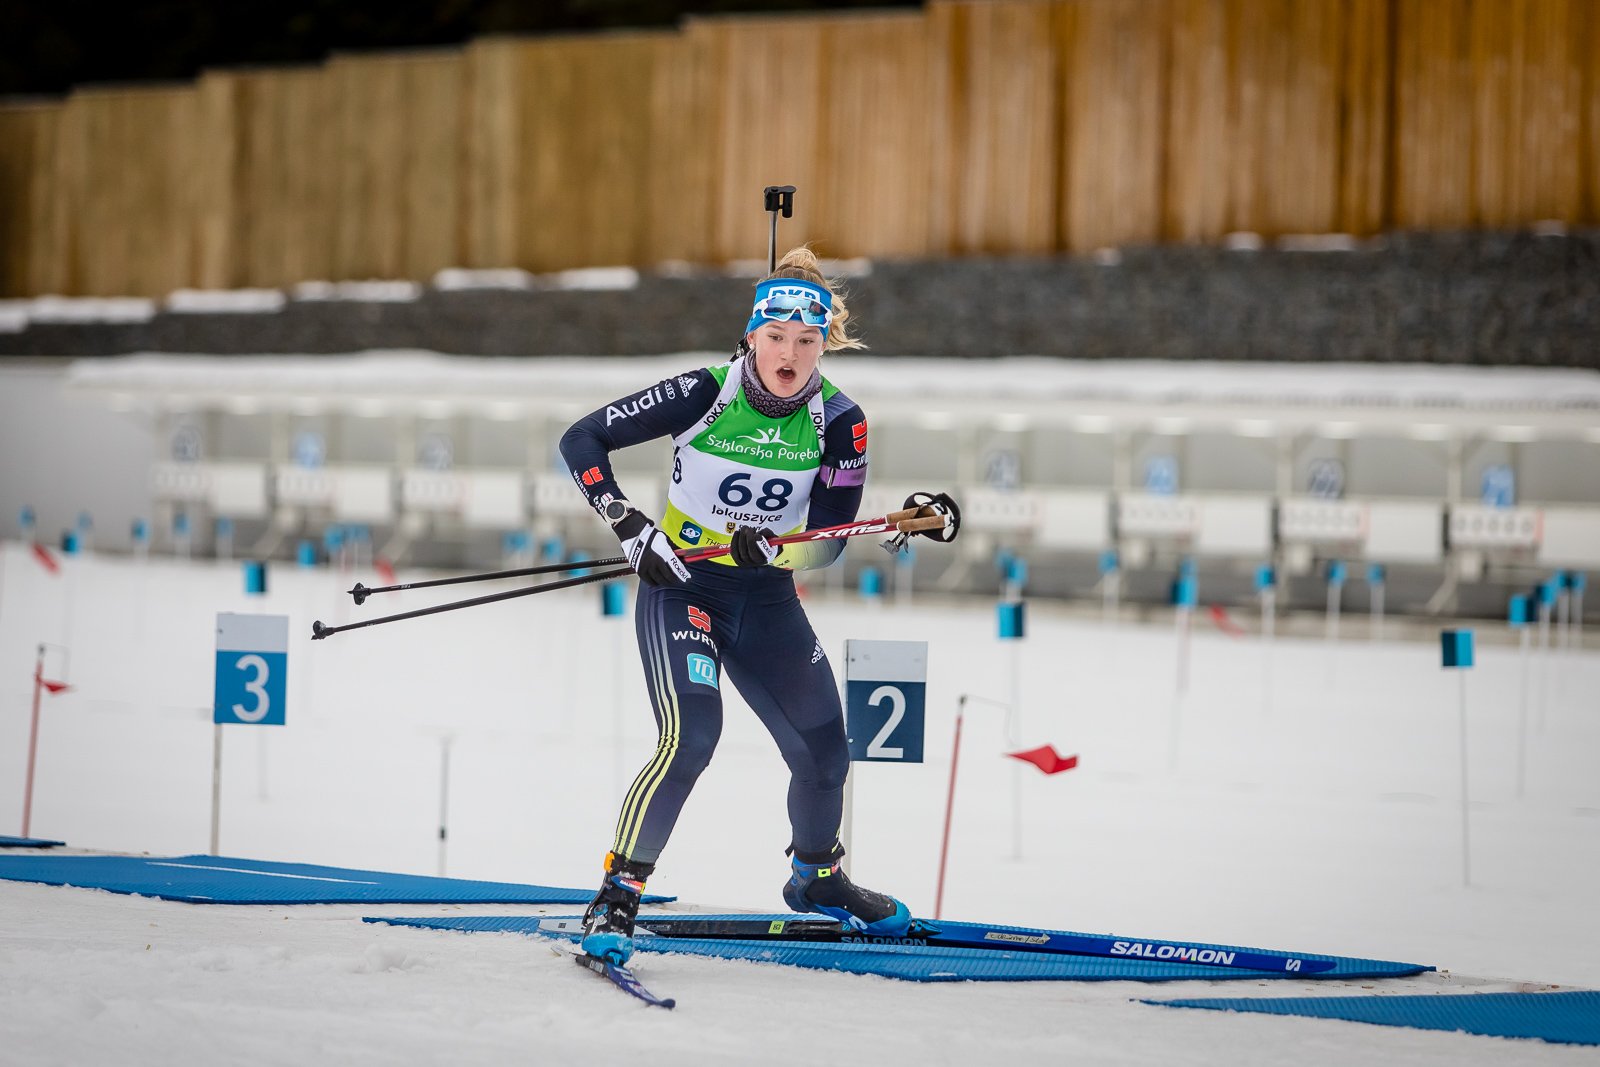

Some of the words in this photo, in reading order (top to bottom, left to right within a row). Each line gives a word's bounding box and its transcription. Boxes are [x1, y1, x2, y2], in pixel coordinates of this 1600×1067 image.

[606, 387, 663, 427] Audi
[703, 401, 728, 427] JOKA
[706, 434, 773, 460] Szklarska
[778, 447, 820, 462] Poręba
[718, 472, 794, 512] 68
[711, 504, 783, 525] Jakuszyce
[693, 657, 716, 684] TQ
[232, 654, 270, 722] 3
[866, 685, 906, 758] 2
[1110, 941, 1236, 965] SALOMON
